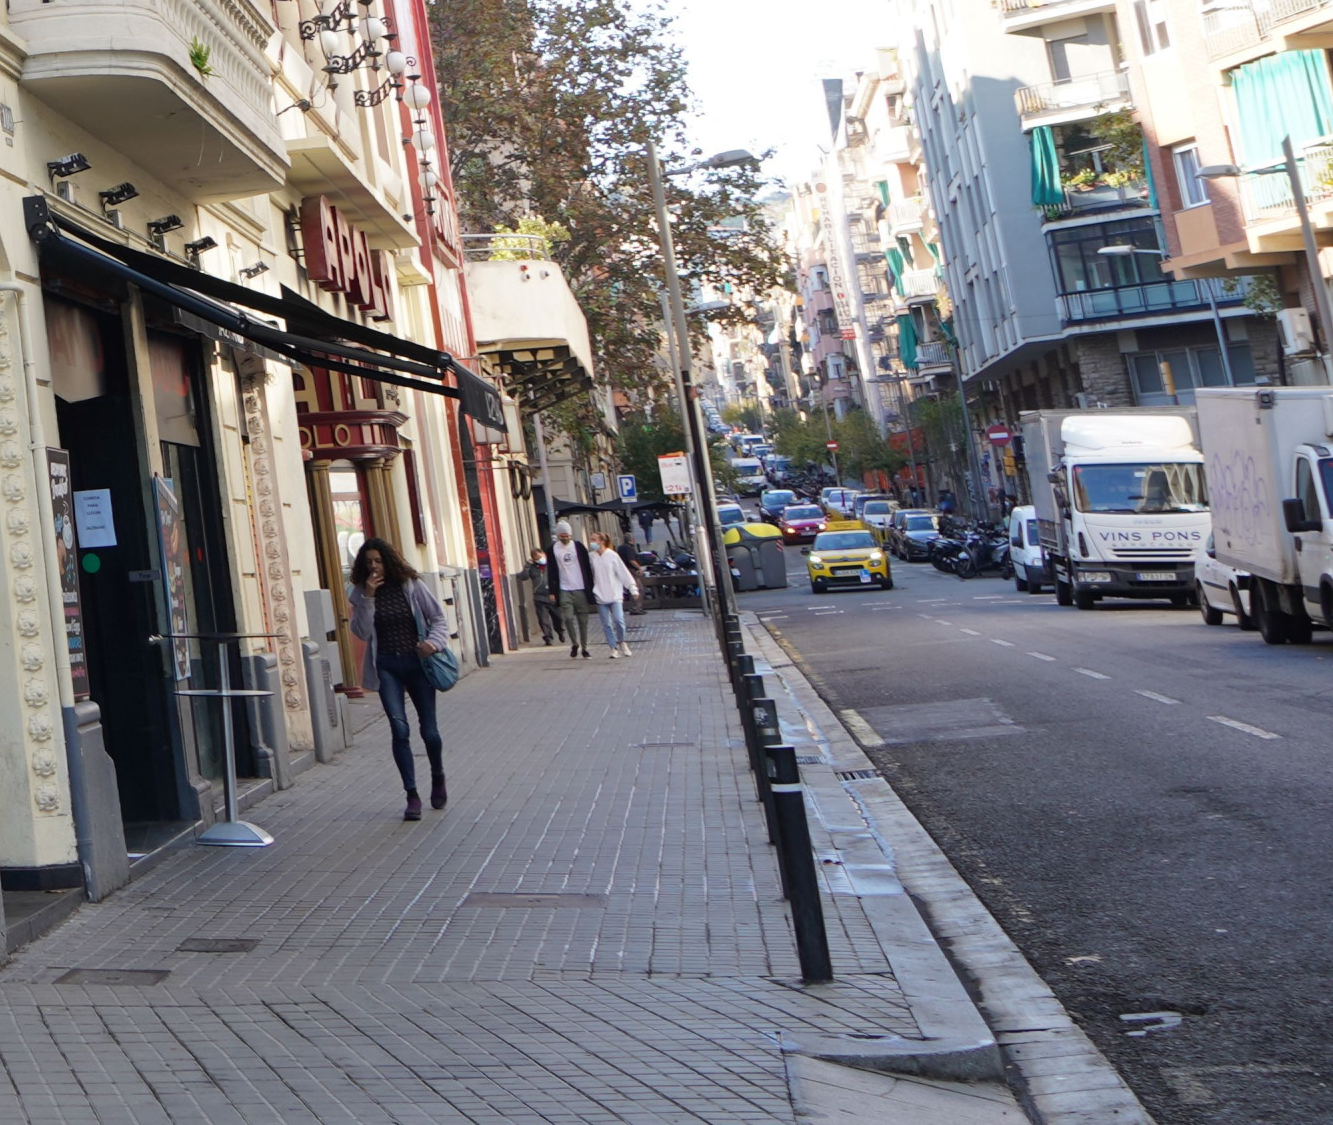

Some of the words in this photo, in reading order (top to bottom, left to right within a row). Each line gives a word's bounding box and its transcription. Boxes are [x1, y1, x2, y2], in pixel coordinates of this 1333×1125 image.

[319, 194, 394, 322] APOLO
[1099, 532, 1142, 541] VINS
[1152, 531, 1202, 541] PONS
